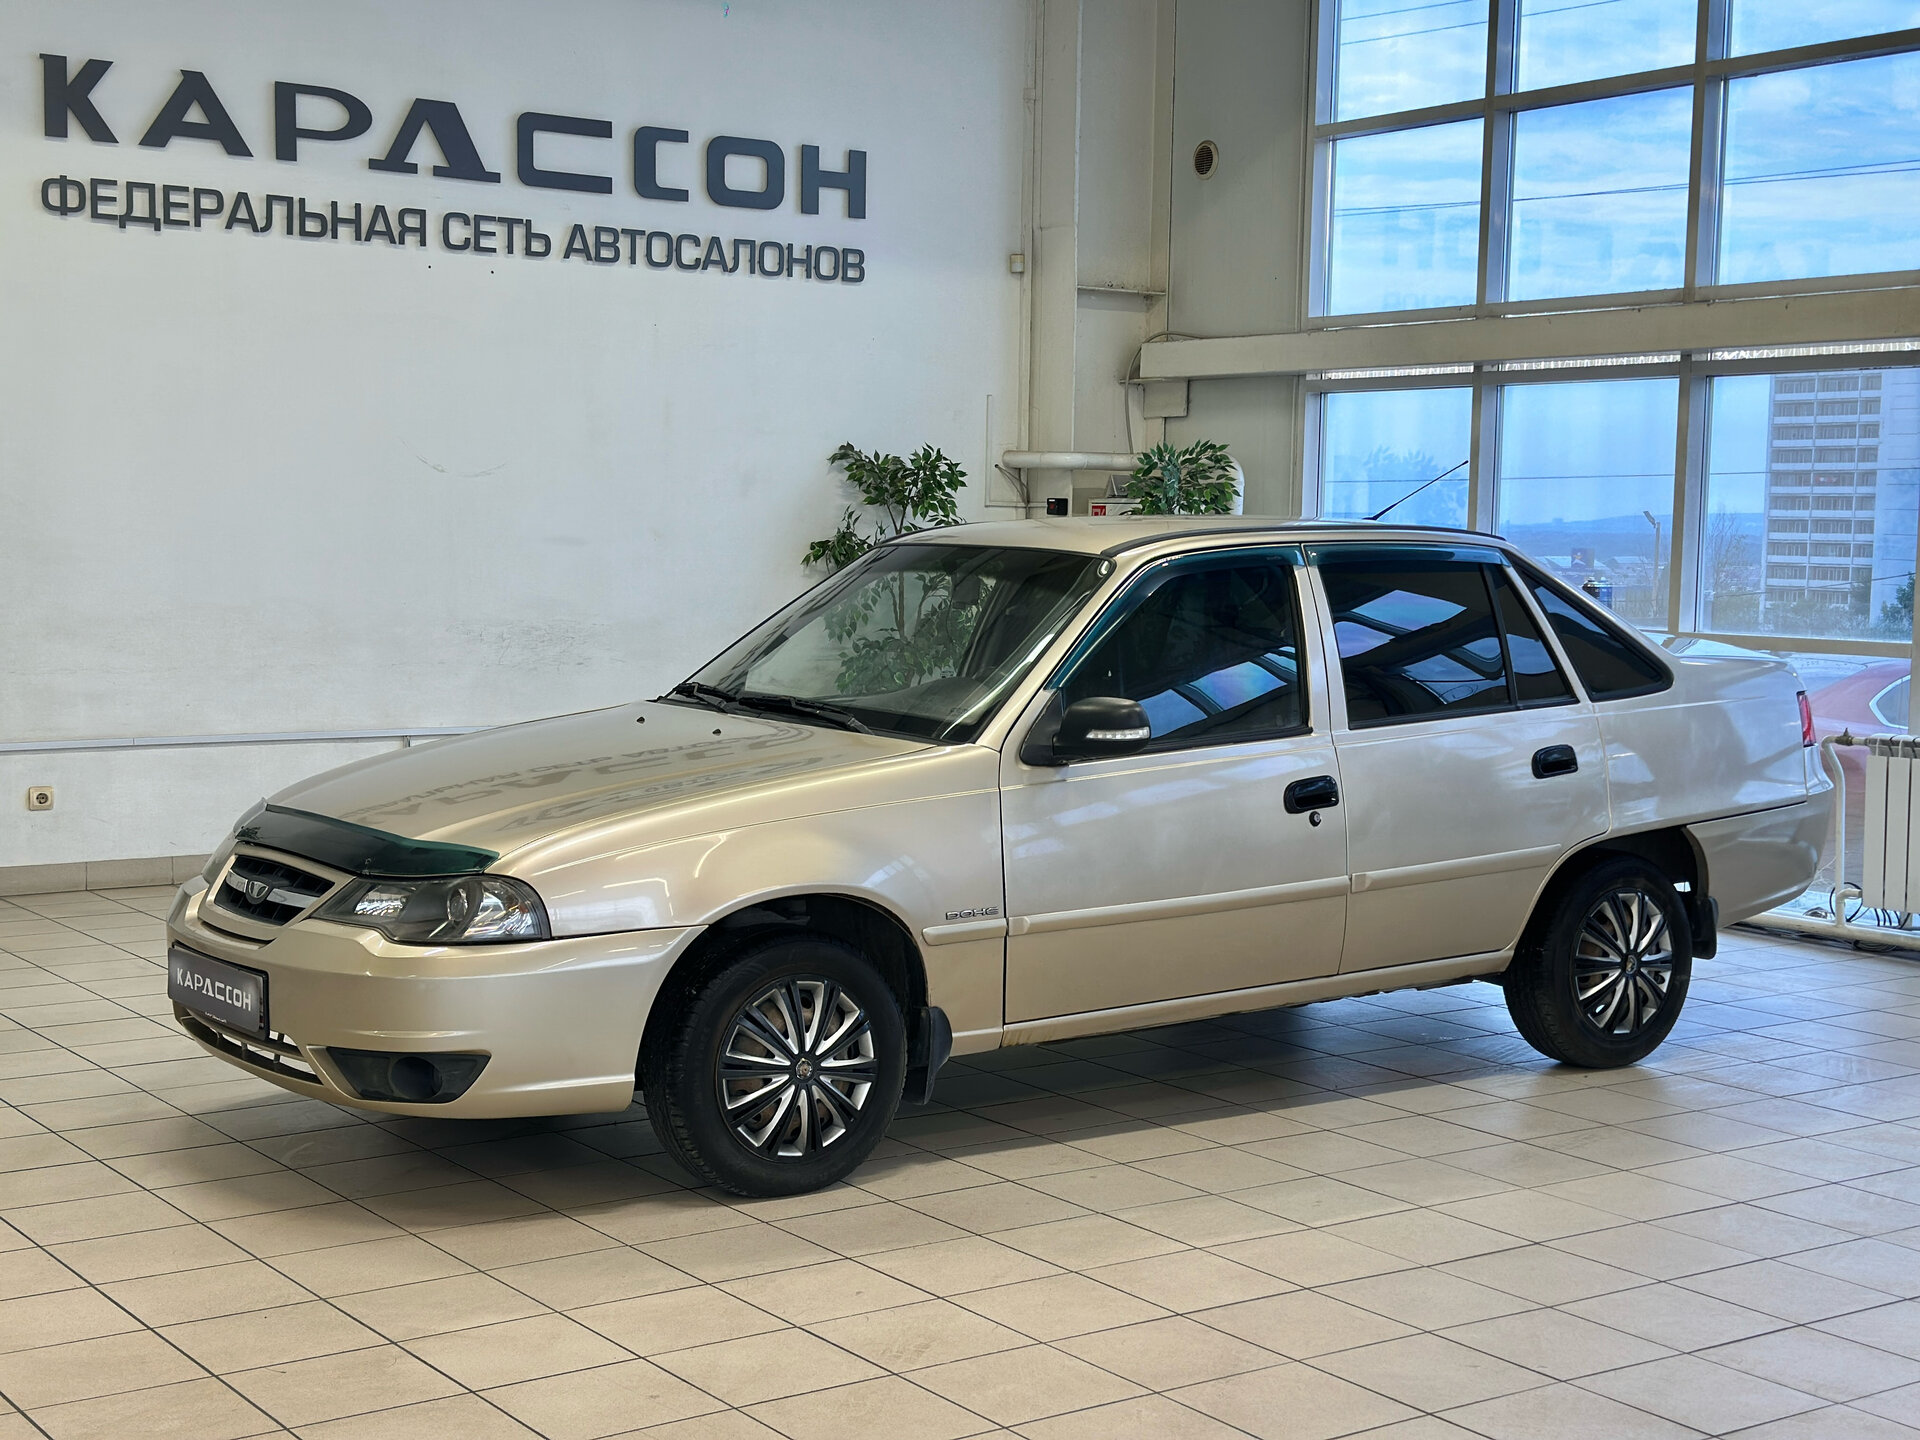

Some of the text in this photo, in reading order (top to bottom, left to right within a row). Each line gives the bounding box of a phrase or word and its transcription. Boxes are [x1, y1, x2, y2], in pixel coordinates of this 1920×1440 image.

[41, 174, 867, 284] ФЕДЕРАЛЬНАЯ СЕТЬ АВТОСАЛОНОВ
